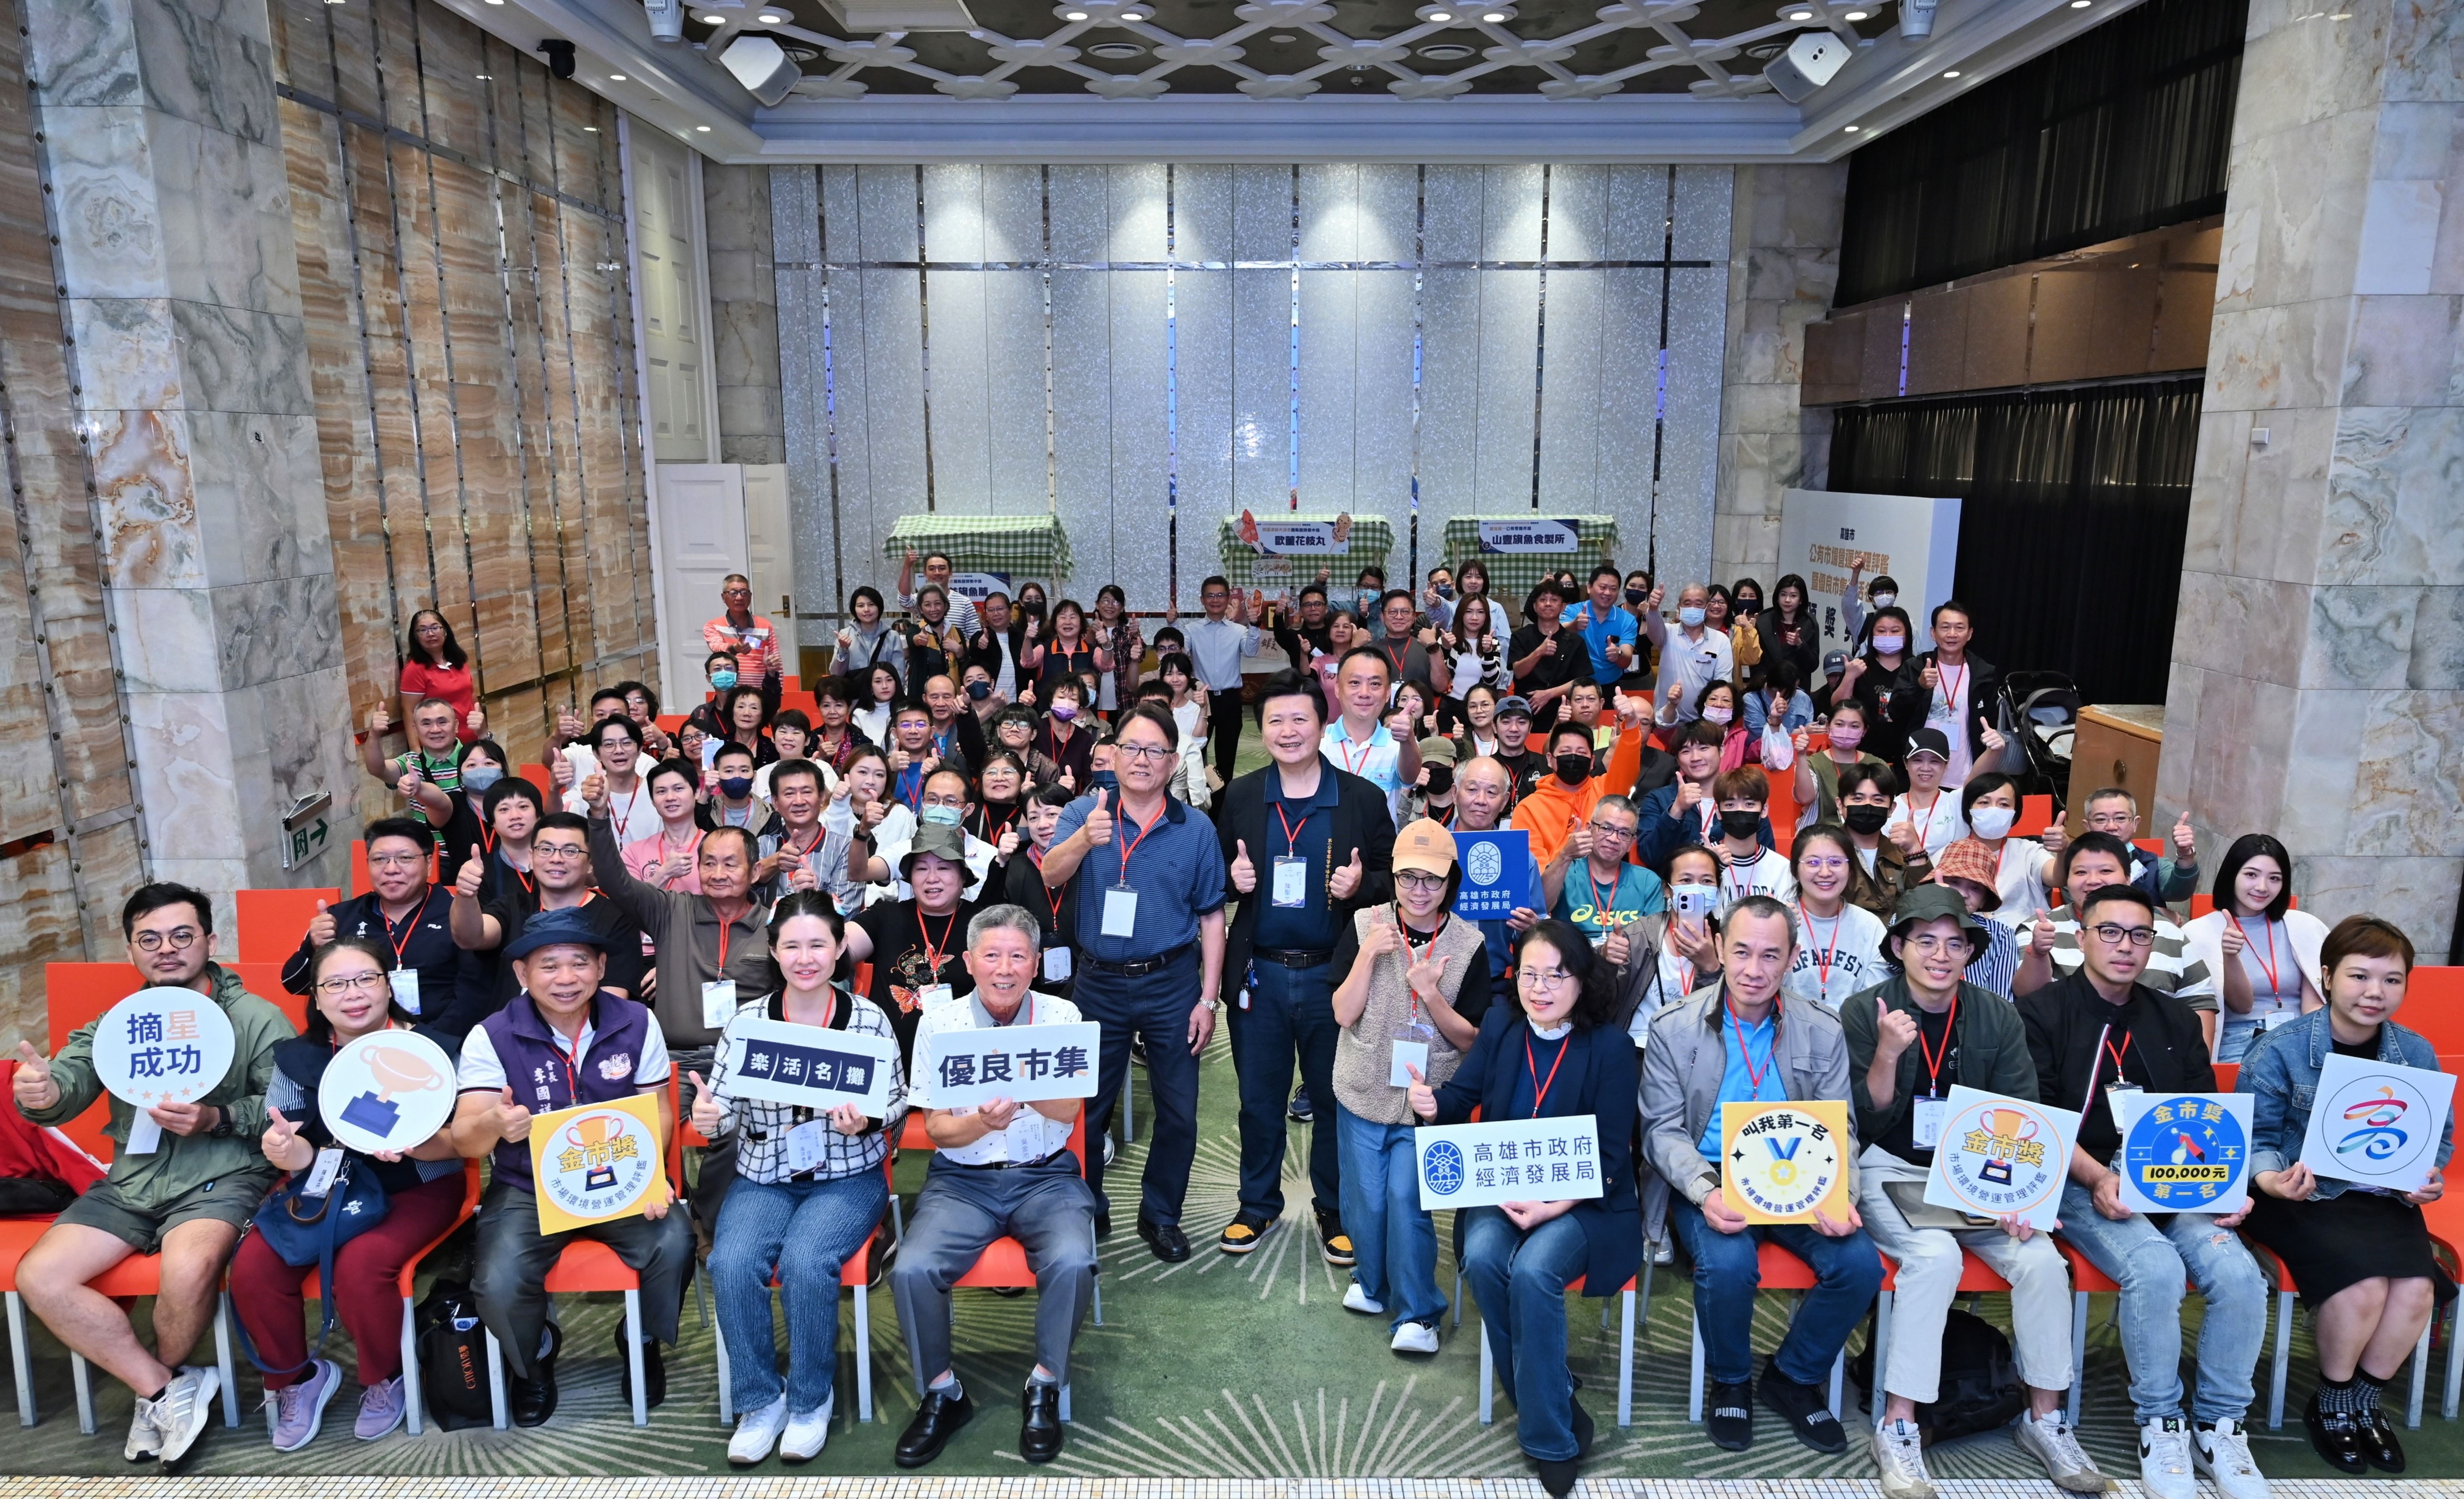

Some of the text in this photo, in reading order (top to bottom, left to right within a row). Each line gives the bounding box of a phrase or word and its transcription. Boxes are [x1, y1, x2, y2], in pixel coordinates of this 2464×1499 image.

[1840, 528, 1855, 541] 高雄市
[1459, 890, 1511, 900] 高雄市政府
[1459, 901, 1511, 912] 經濟發展局
[127, 1010, 200, 1045] 摘星
[129, 1045, 202, 1080] 成功
[545, 1060, 559, 1083] 會長
[749, 1052, 866, 1089] 楽活名攤
[938, 1045, 1089, 1088] 優良市集
[1742, 1113, 1829, 1142] 叫我第一名
[2152, 1101, 2225, 1125] 金市獎
[558, 1134, 639, 1173] 金市獎
[1474, 1135, 1594, 1163] 高雄市政府
[1962, 1128, 2046, 1168] 金市獎
[551, 1159, 648, 1210] 市場環境營運管理評鑑
[1475, 1162, 1595, 1188] 經濟發展局
[1948, 1152, 2049, 1204] 市場環境營運管理評鑑
[1740, 1175, 1828, 1213] 市場環境營運管理評鑑
[2152, 1182, 2217, 1200] 第一名
[1715, 1407, 1748, 1420] PUMA
